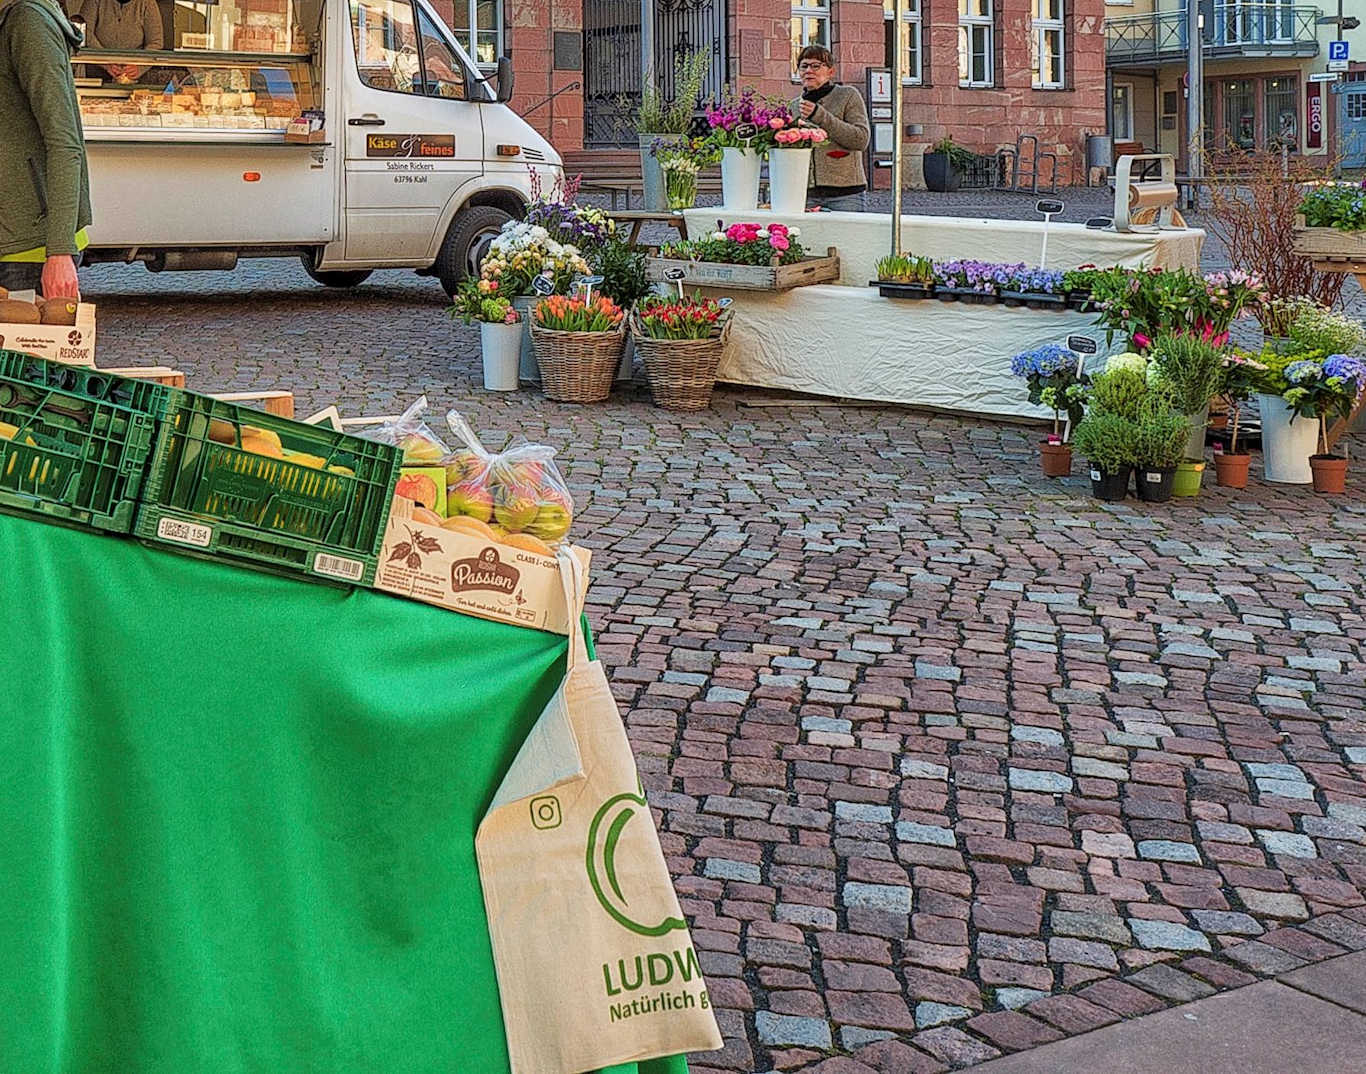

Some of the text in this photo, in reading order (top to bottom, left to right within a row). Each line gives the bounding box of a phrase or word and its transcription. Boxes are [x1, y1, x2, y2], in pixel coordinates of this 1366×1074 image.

[1333, 43, 1345, 58] P
[1311, 96, 1322, 133] ERGO
[368, 136, 397, 149] Käse
[420, 142, 454, 156] feines
[387, 162, 435, 171] Sabine Rickert
[414, 175, 428, 183] Kahl
[59, 347, 90, 359] REDSTAR
[191, 527, 208, 540] 154
[516, 553, 535, 565] CLASS
[454, 565, 515, 591] Passion
[456, 597, 467, 606] For
[609, 989, 695, 1023] Natürlich
